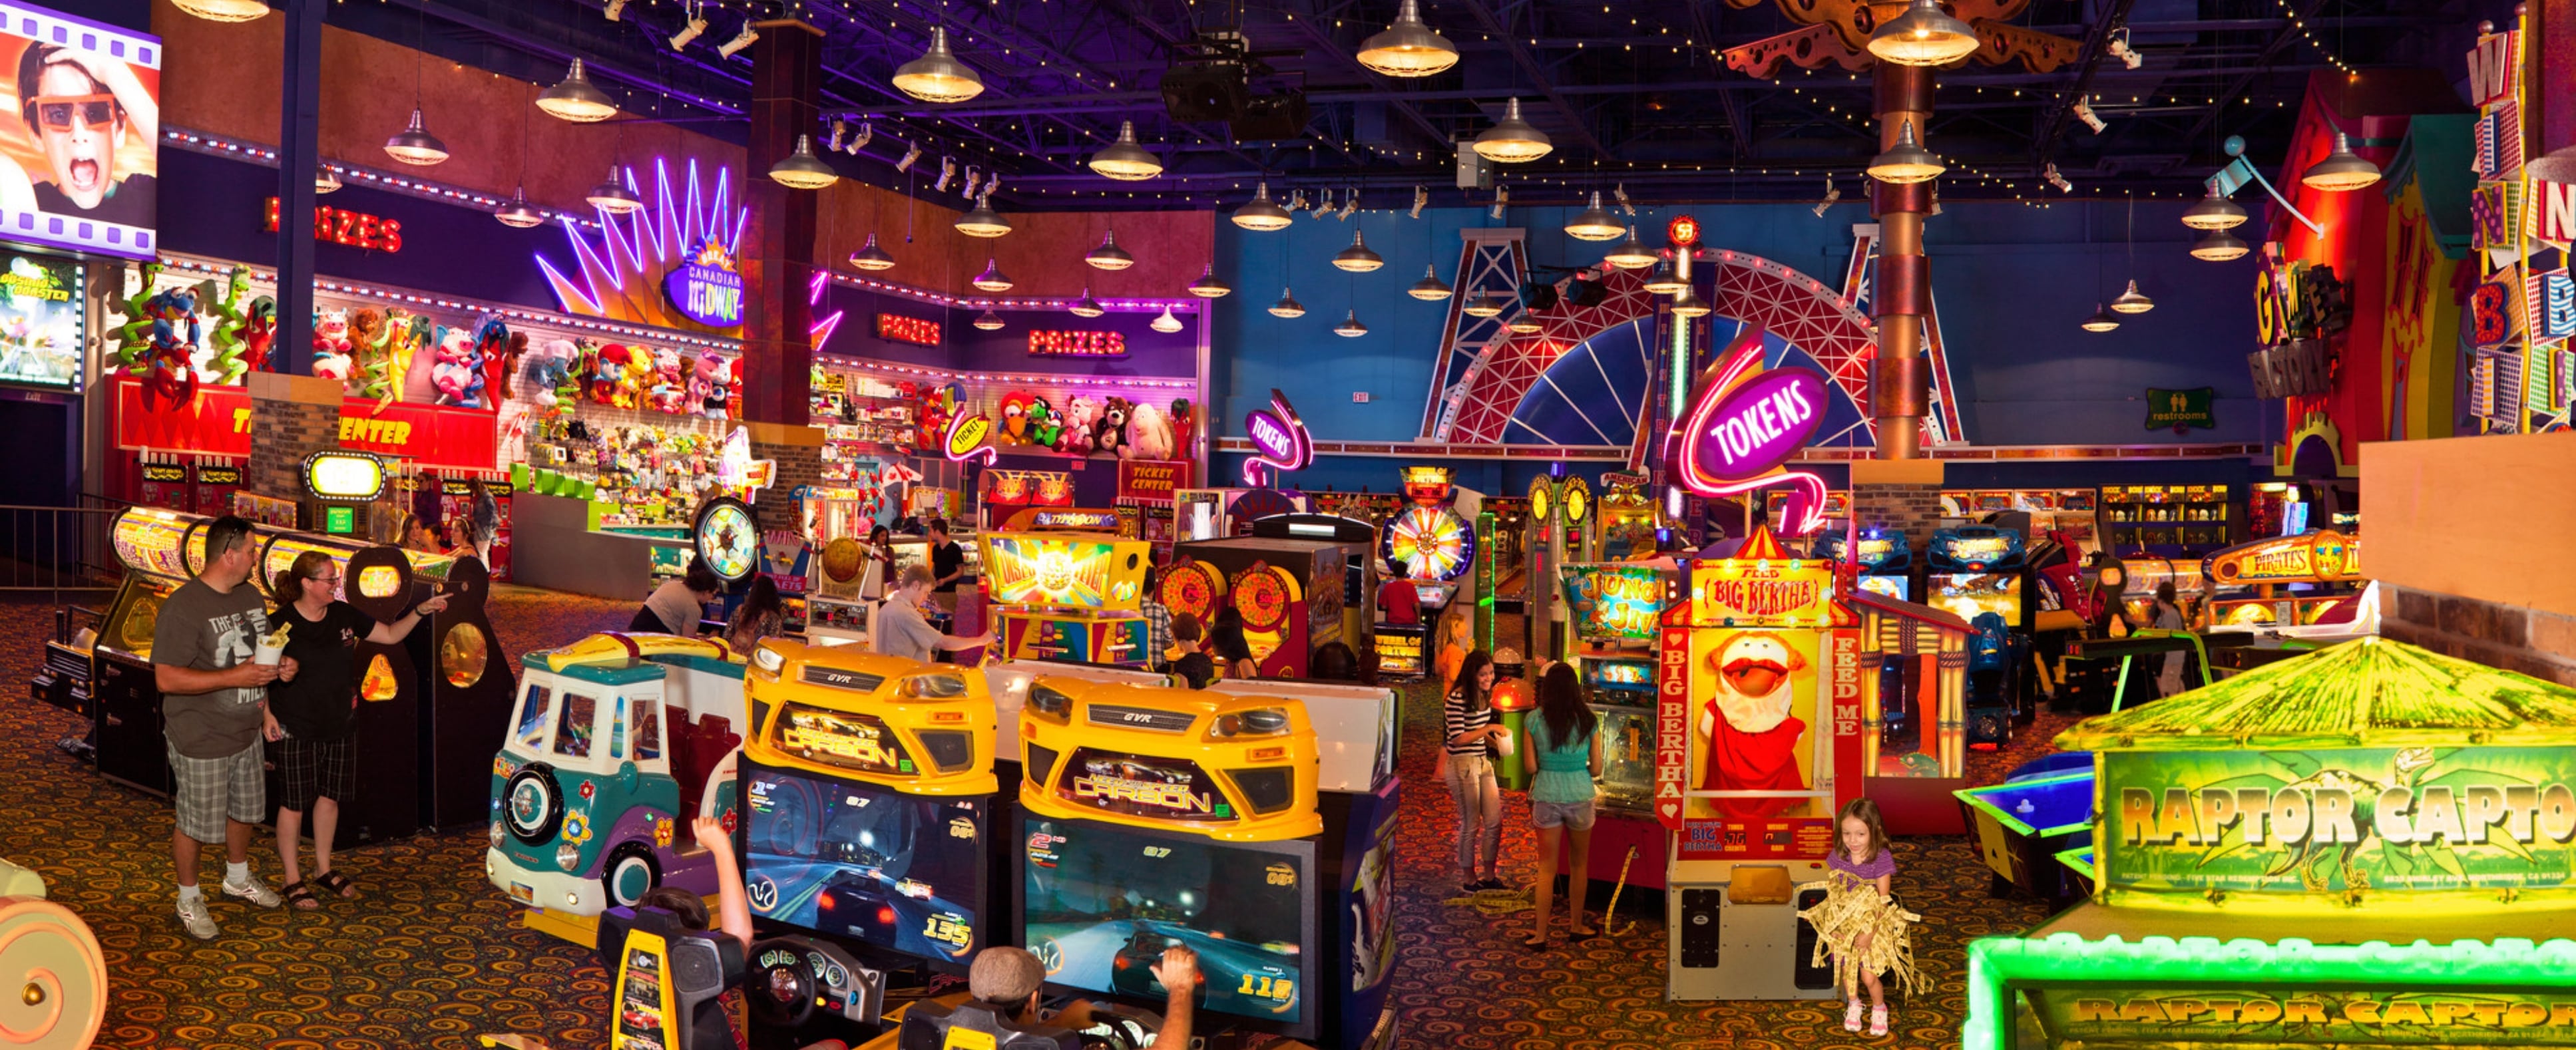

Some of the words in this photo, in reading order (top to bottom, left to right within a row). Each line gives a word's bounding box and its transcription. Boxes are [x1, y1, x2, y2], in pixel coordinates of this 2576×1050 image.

[264, 197, 402, 253] IZES
[688, 266, 741, 287] CANADIAN
[1028, 329, 1126, 355] PRIZES
[1710, 379, 1812, 466] TOKENS
[2153, 413, 2207, 421] restrooms
[338, 416, 411, 446] ENTER
[955, 420, 980, 446] TICKET
[1252, 415, 1291, 456] TOKENS
[1132, 478, 1174, 491] CENTER
[1133, 467, 1174, 479] TICKET
[1604, 473, 1647, 484] AMERICAN
[2254, 550, 2306, 573] PIRATES
[1713, 580, 1744, 613] BIG
[1747, 580, 1811, 615] BERTHA
[827, 673, 853, 684] GVR
[1663, 650, 1686, 696] BIG
[1834, 637, 1858, 699] FEED
[1124, 713, 1152, 723] GVR
[1835, 705, 1859, 736] ME
[783, 729, 896, 767] CARBON
[1656, 702, 1685, 798] BERTHA
[1074, 776, 1211, 812] CARBON
[2120, 786, 2358, 846] RAPTOR
[1684, 842, 1723, 852] BERTHA
[1691, 828, 1716, 841] BIG
[923, 918, 972, 944] 135
[2077, 998, 2329, 1024] RAPTOR
